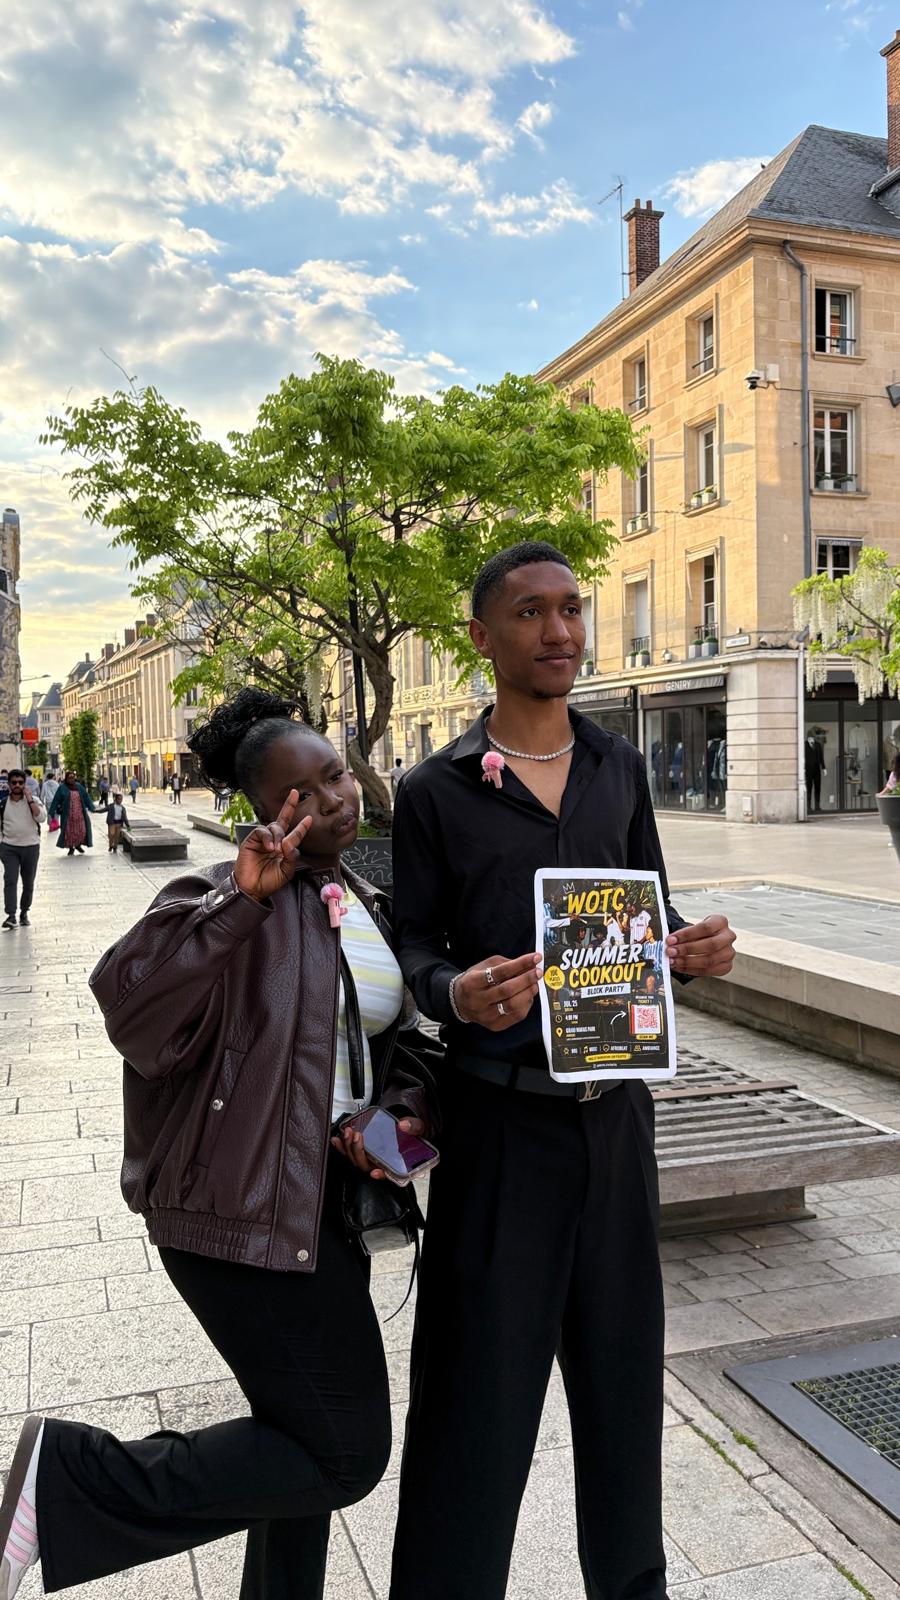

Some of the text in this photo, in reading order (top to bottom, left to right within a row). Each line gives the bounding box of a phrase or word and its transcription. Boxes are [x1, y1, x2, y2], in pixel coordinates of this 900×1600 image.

[666, 680, 691, 692] GENTRY
[568, 888, 625, 915] WOTC
[561, 944, 642, 970] SUMMER
[569, 963, 646, 988] COOKOUT
[588, 987, 602, 995] BLOCK
